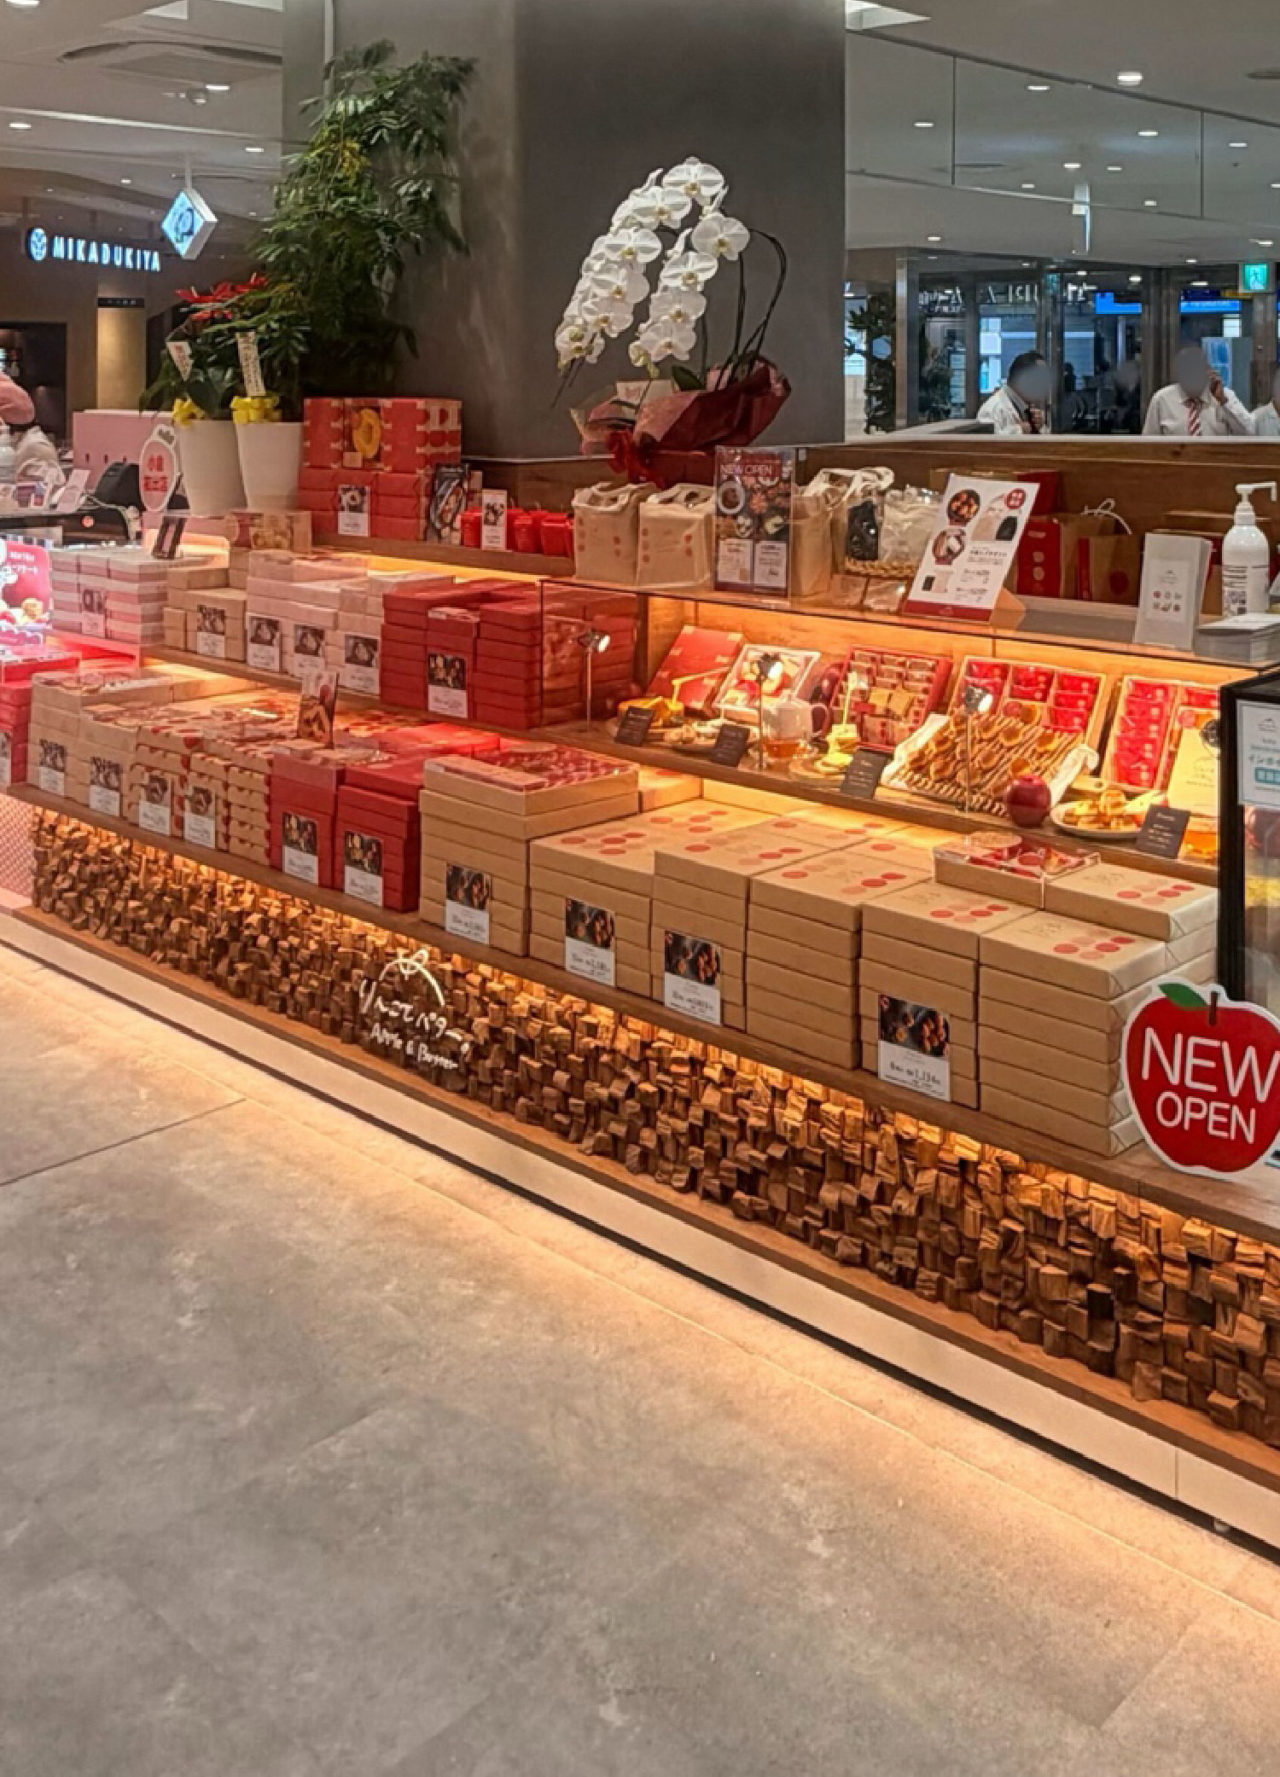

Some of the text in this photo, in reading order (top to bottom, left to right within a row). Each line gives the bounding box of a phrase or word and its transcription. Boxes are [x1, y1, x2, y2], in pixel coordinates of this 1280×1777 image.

[52, 235, 161, 272] MIKADUKIYA
[744, 464, 773, 476] OPEN
[1155, 1091, 1257, 1145] OPEN
